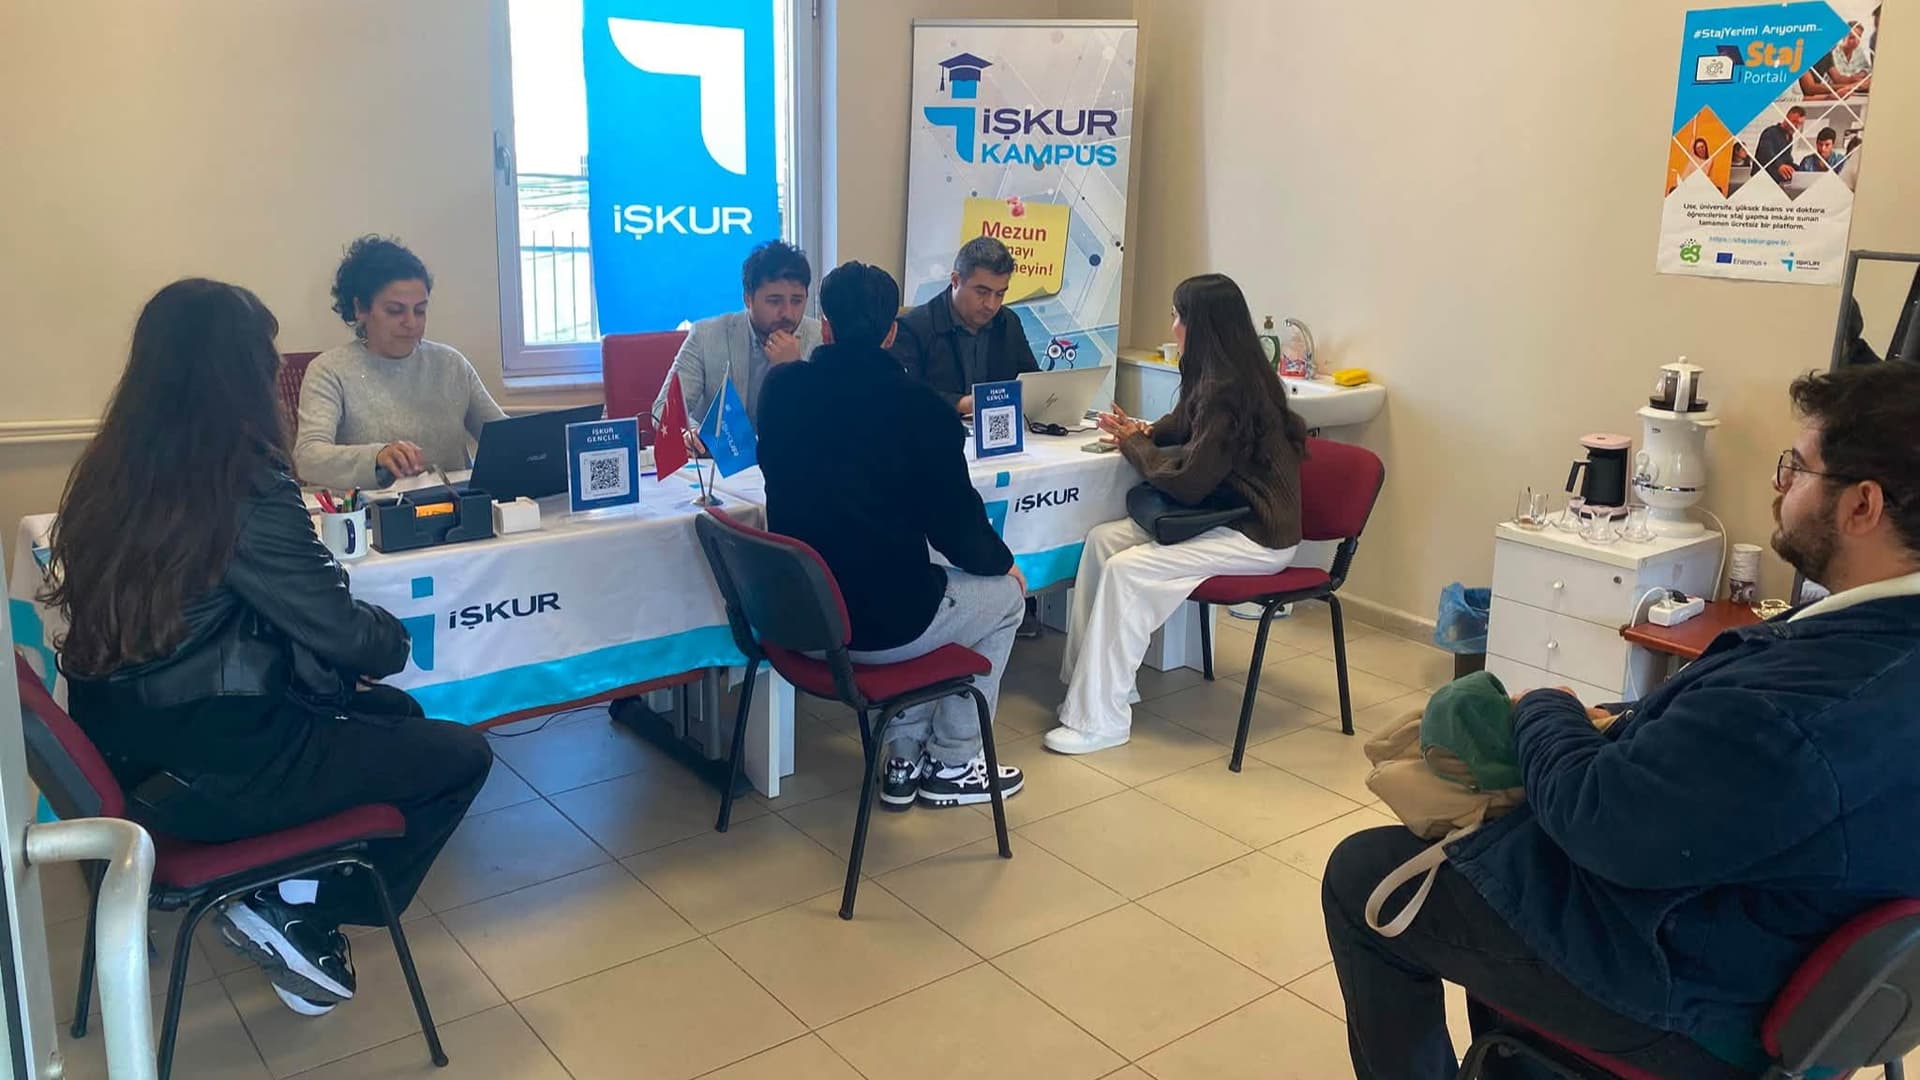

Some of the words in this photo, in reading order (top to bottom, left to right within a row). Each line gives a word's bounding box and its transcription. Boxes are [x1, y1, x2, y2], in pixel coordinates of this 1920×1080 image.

[1694, 26, 1758, 39] #StajYerimi
[1746, 38, 1804, 73] Staj
[1743, 70, 1787, 84] Portalı
[981, 143, 1117, 167] KAMPÜS
[981, 220, 1048, 242] Mezun
